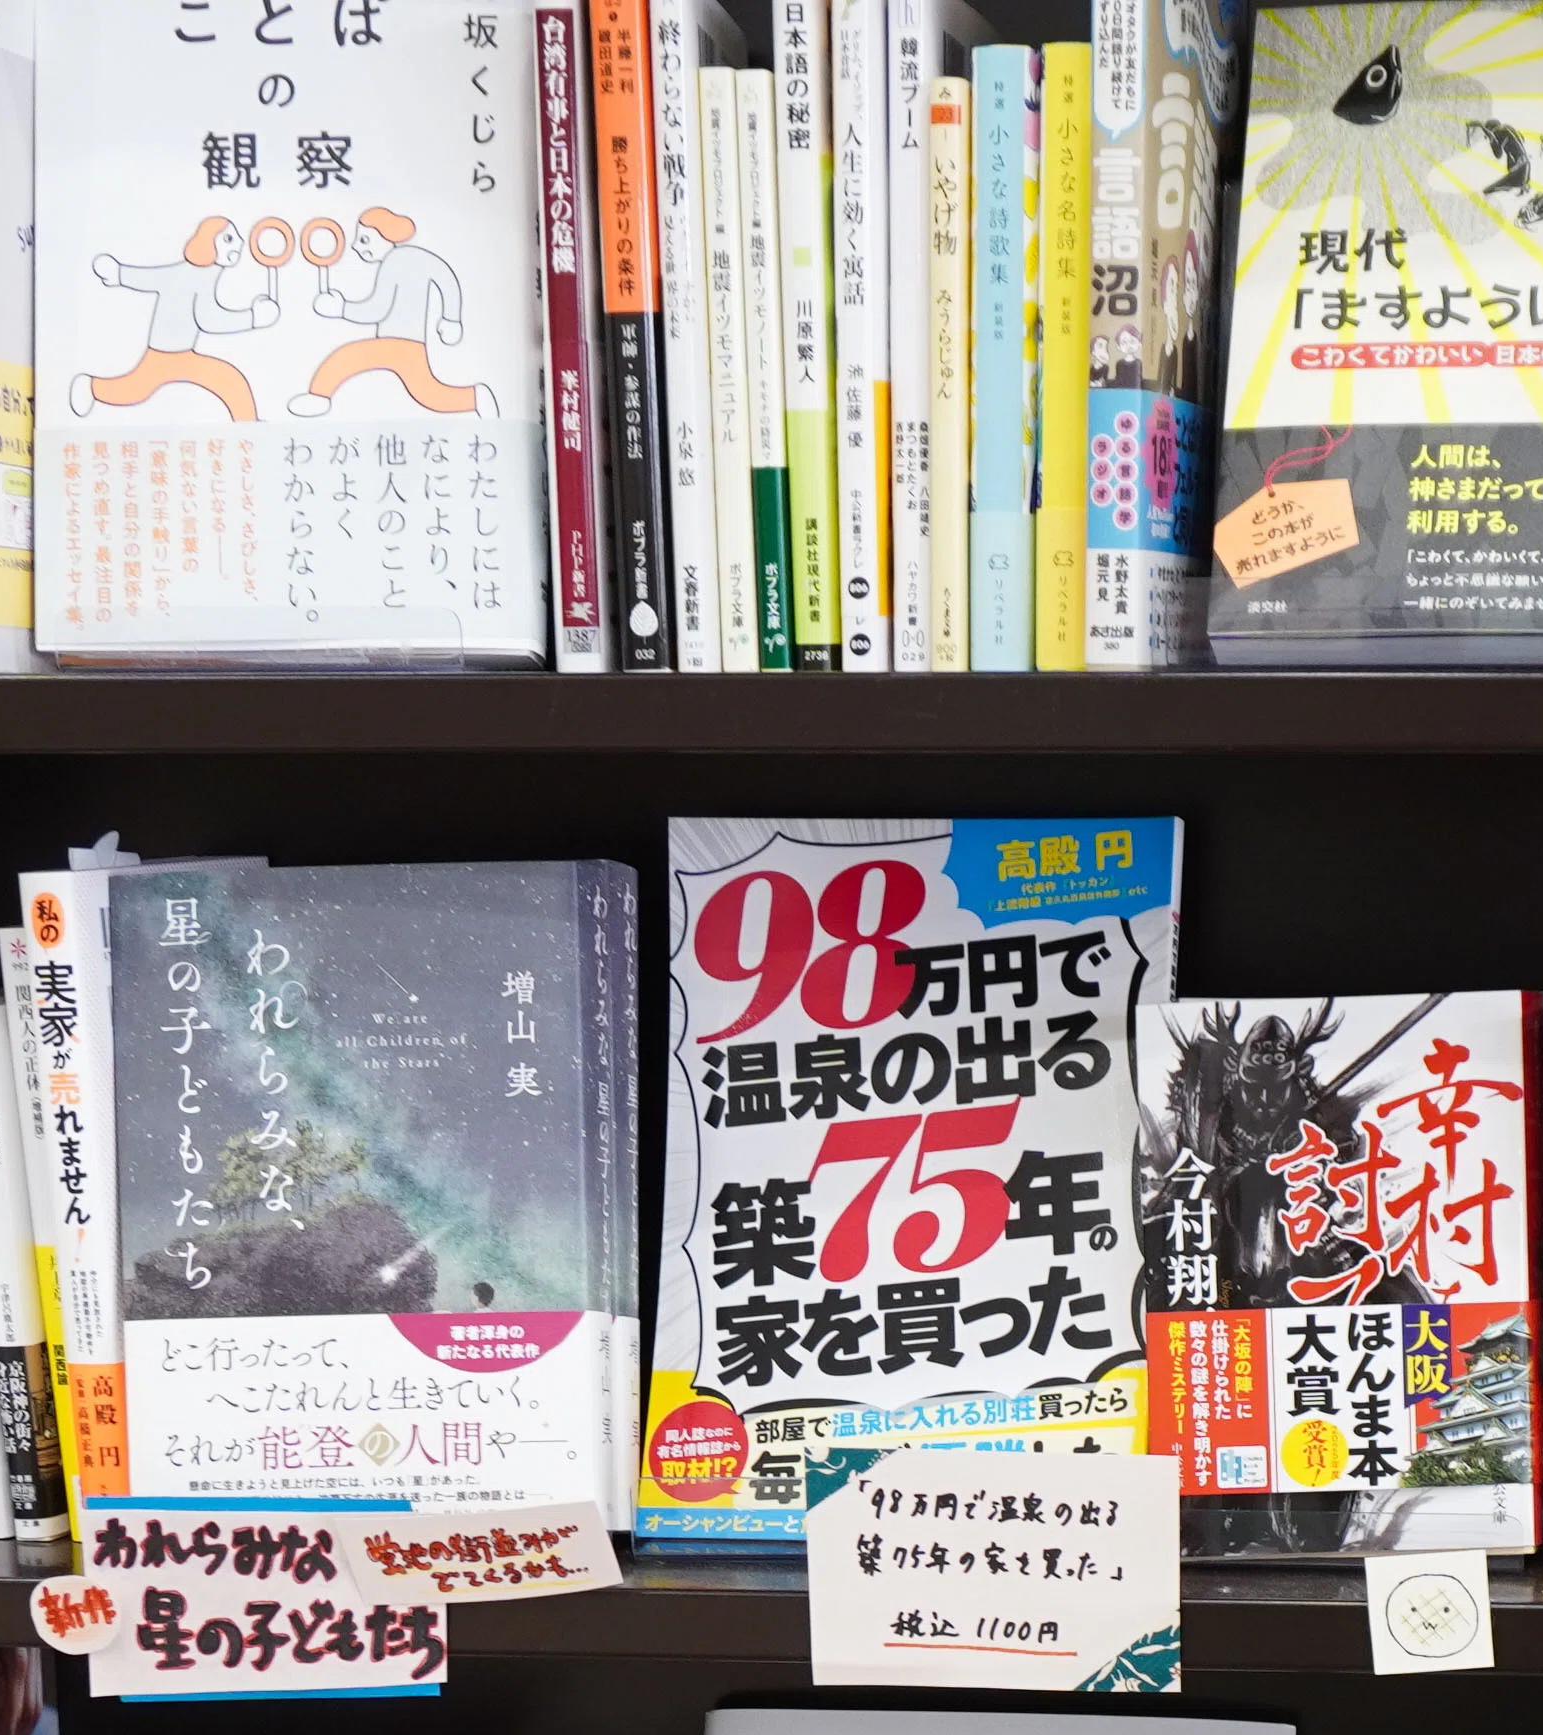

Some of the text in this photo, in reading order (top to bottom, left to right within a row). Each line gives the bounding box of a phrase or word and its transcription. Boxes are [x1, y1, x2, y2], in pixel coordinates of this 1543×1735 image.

[543, 15, 578, 275] 台湾有事と日本の危機
[899, 38, 922, 151] 韓流ブーム
[202, 131, 354, 189] 観察
[933, 155, 958, 256] いやげ物
[987, 123, 1011, 286] 小さな詩歌集
[1056, 116, 1079, 280] 小さな名詩集
[611, 136, 636, 298] 勝ち上がりの条件
[842, 123, 867, 308] 人生に効く寓話
[1299, 228, 1408, 274] 現代
[620, 322, 644, 460] 軍師・参謀の作法
[795, 300, 816, 384] 川原繁人
[937, 288, 954, 401] みうらじゅん
[1299, 344, 1483, 368] こわくてかわいい
[328, 436, 360, 540] がよく
[1410, 444, 1501, 470] 人間は、
[283, 436, 320, 624] わからない。
[375, 435, 408, 610] 他人のこと
[422, 435, 459, 590] なにより、
[468, 435, 502, 610] わたしには
[570, 530, 587, 599] PHP新書
[631, 520, 650, 599] ポプラ新書
[1407, 509, 1522, 535] 利用する。
[683, 564, 701, 633] 文春新書
[805, 518, 821, 623] 講談社現代新書
[996, 829, 1135, 881] 高殿 円
[693, 859, 1111, 1046] 98万円で
[245, 927, 308, 1231] われらみな、
[502, 971, 541, 1099] 増山 実
[701, 1016, 1111, 1131] 温泉の出る
[159, 897, 215, 1291] 星の子どもたち
[711, 1095, 1118, 1290] 築75年の
[161, 1336, 350, 1373] どこ行ったって、
[717, 1266, 1114, 1387] 家を買った
[1286, 1314, 1340, 1416] 大賞
[1405, 1309, 1451, 1396] 大阪
[206, 1377, 541, 1414] へこたれんと生きていく。
[1347, 1310, 1400, 1486] ほんま本
[93, 1519, 338, 1584] われらみな
[38, 1581, 118, 1637] 新作
[136, 1588, 448, 1682] 星の子どもたち
[885, 1610, 1061, 1644] 税込 1100円
